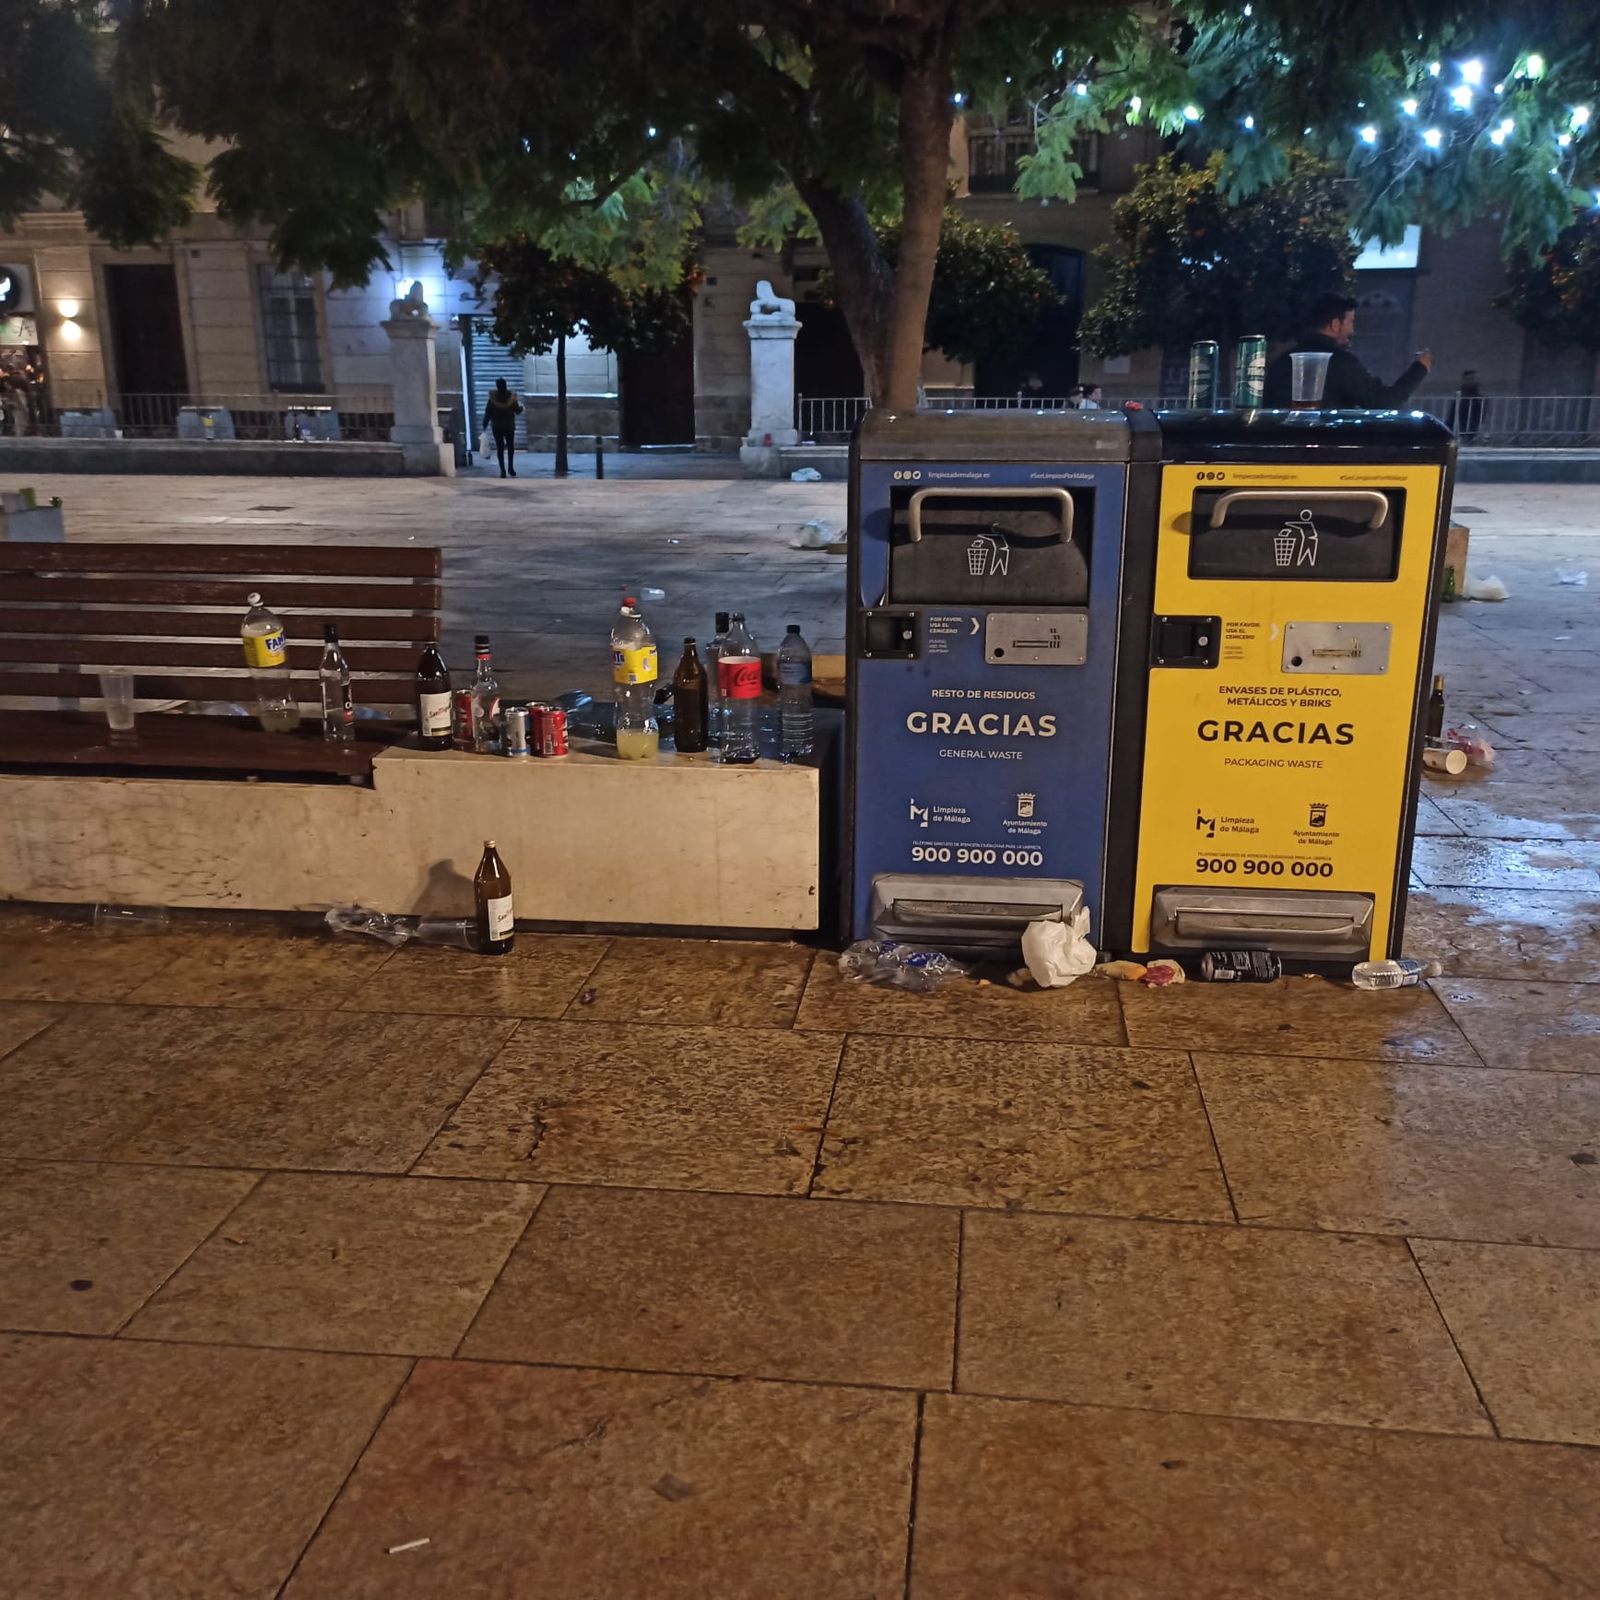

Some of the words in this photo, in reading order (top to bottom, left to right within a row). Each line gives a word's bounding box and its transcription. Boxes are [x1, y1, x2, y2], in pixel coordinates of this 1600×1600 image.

[265, 633, 285, 650] FAN
[931, 689, 965, 698] RESTO
[967, 690, 981, 699] DE
[983, 690, 1036, 700] RESIDUOS
[1219, 685, 1267, 695] ENVASES
[1269, 687, 1285, 695] DE
[1287, 686, 1342, 697] PLÁSTICO,
[1227, 697, 1288, 707] METÁLICOS
[1290, 698, 1298, 707] Y
[1299, 699, 1332, 708] BRIKS
[906, 711, 1057, 737] GRACIAS
[1197, 719, 1354, 745] GRACIAS
[939, 749, 987, 759] GENERAL
[988, 751, 1023, 760] WASTE
[1224, 757, 1285, 768] PACKAGING
[1287, 759, 1324, 769] WASTE
[933, 806, 966, 815] Limpieza
[943, 815, 971, 824] Málaga
[1220, 816, 1255, 825] Limpieza
[1231, 825, 1260, 834] Málaga
[911, 846, 951, 863] 900
[956, 848, 997, 864] 900
[1002, 850, 1043, 866] 000
[1196, 858, 1237, 874] 900
[1243, 859, 1285, 876] 900
[1290, 861, 1334, 878] 000
